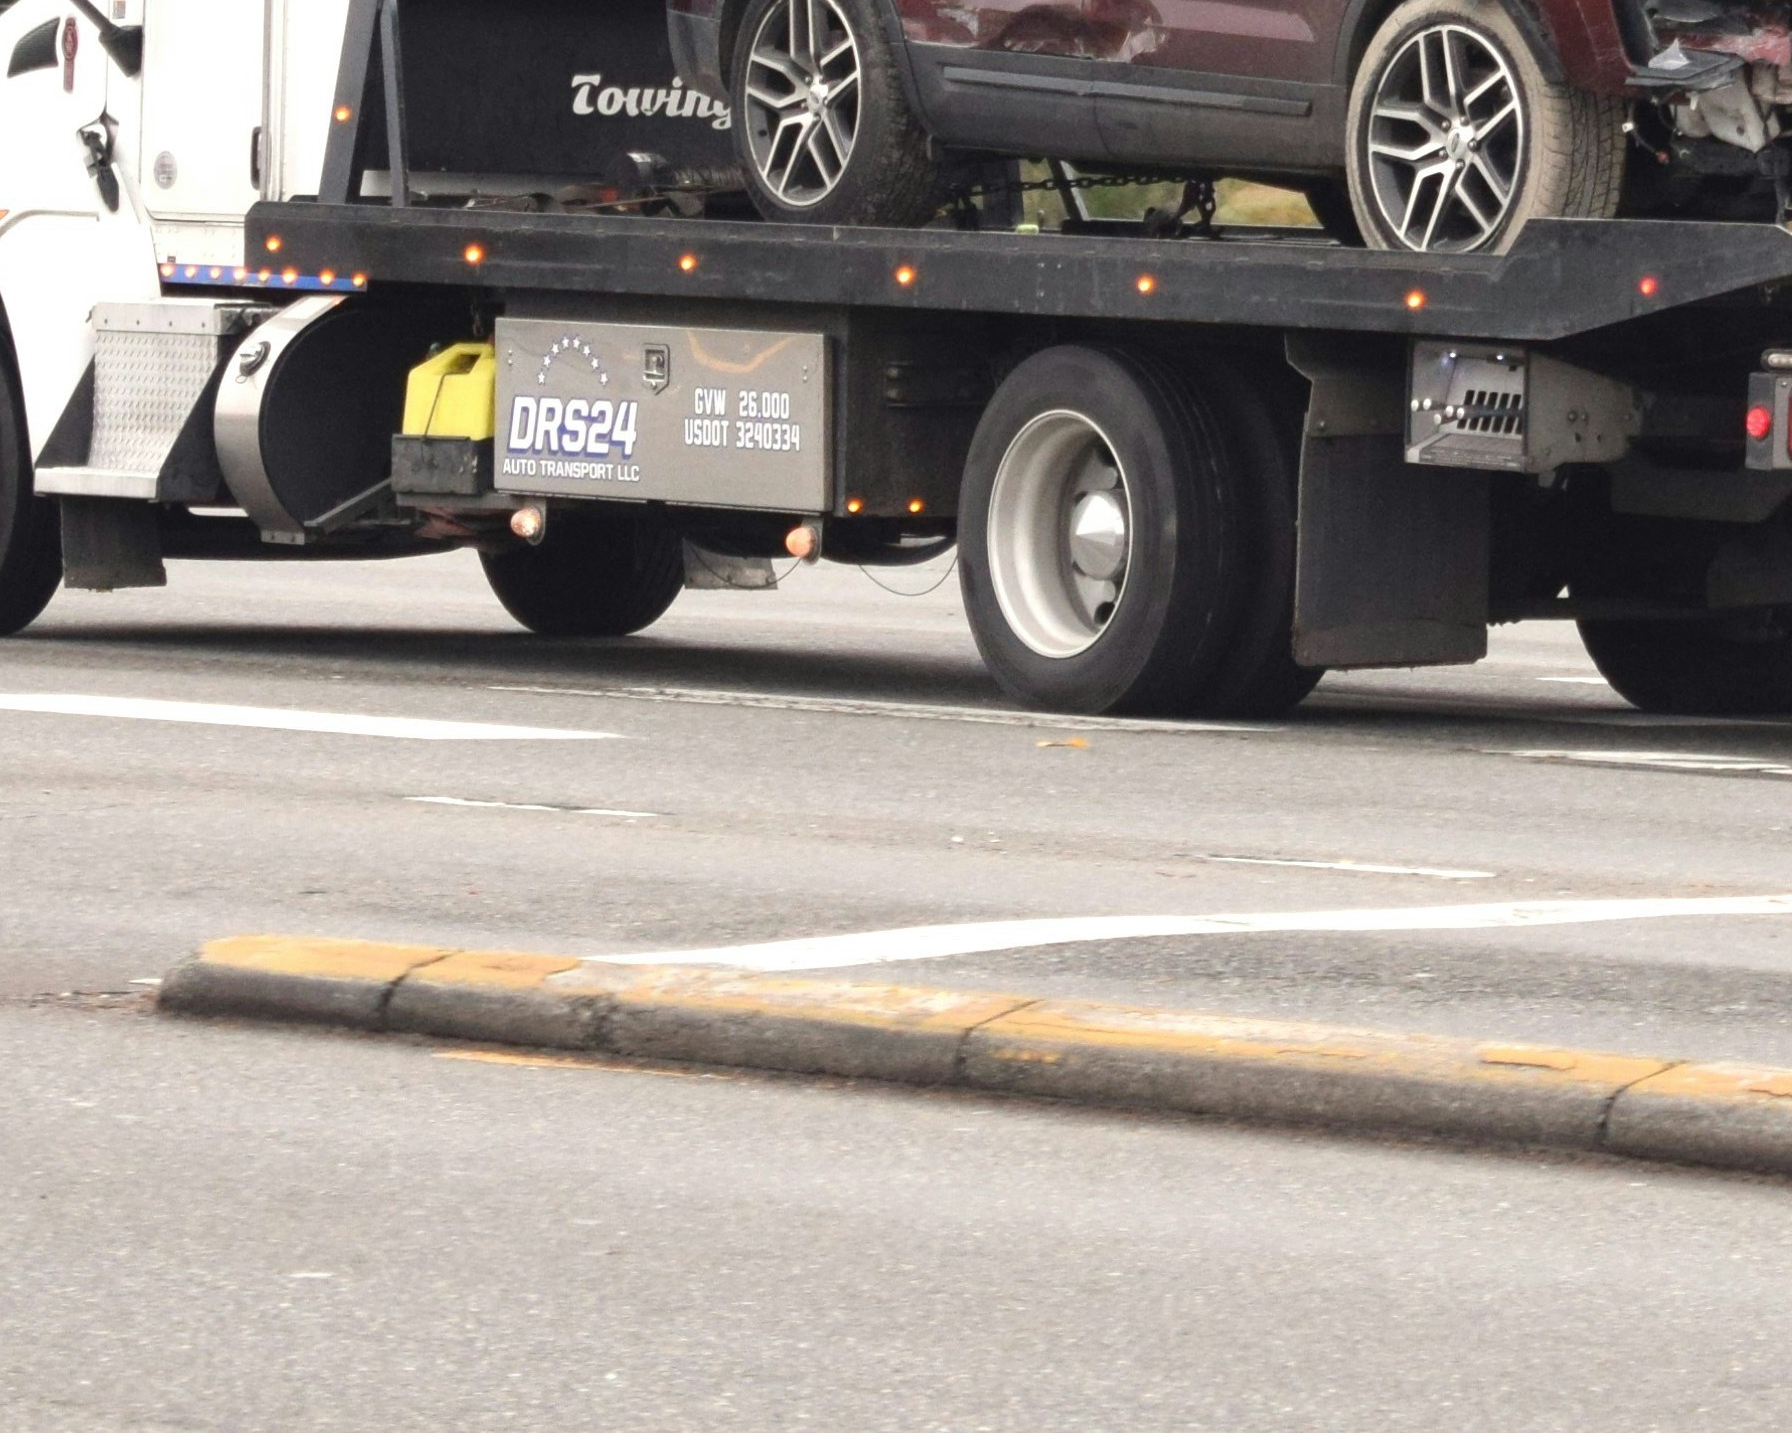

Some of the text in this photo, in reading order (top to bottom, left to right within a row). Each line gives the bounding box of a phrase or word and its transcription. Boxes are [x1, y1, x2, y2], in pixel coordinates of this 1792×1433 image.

[571, 74, 732, 130] Towing
[694, 387, 726, 415] GVW
[508, 396, 638, 457] DRS24
[684, 418, 800, 451] USDOT 3240334
[503, 458, 640, 482] AUTO TRANSPORT LLC
